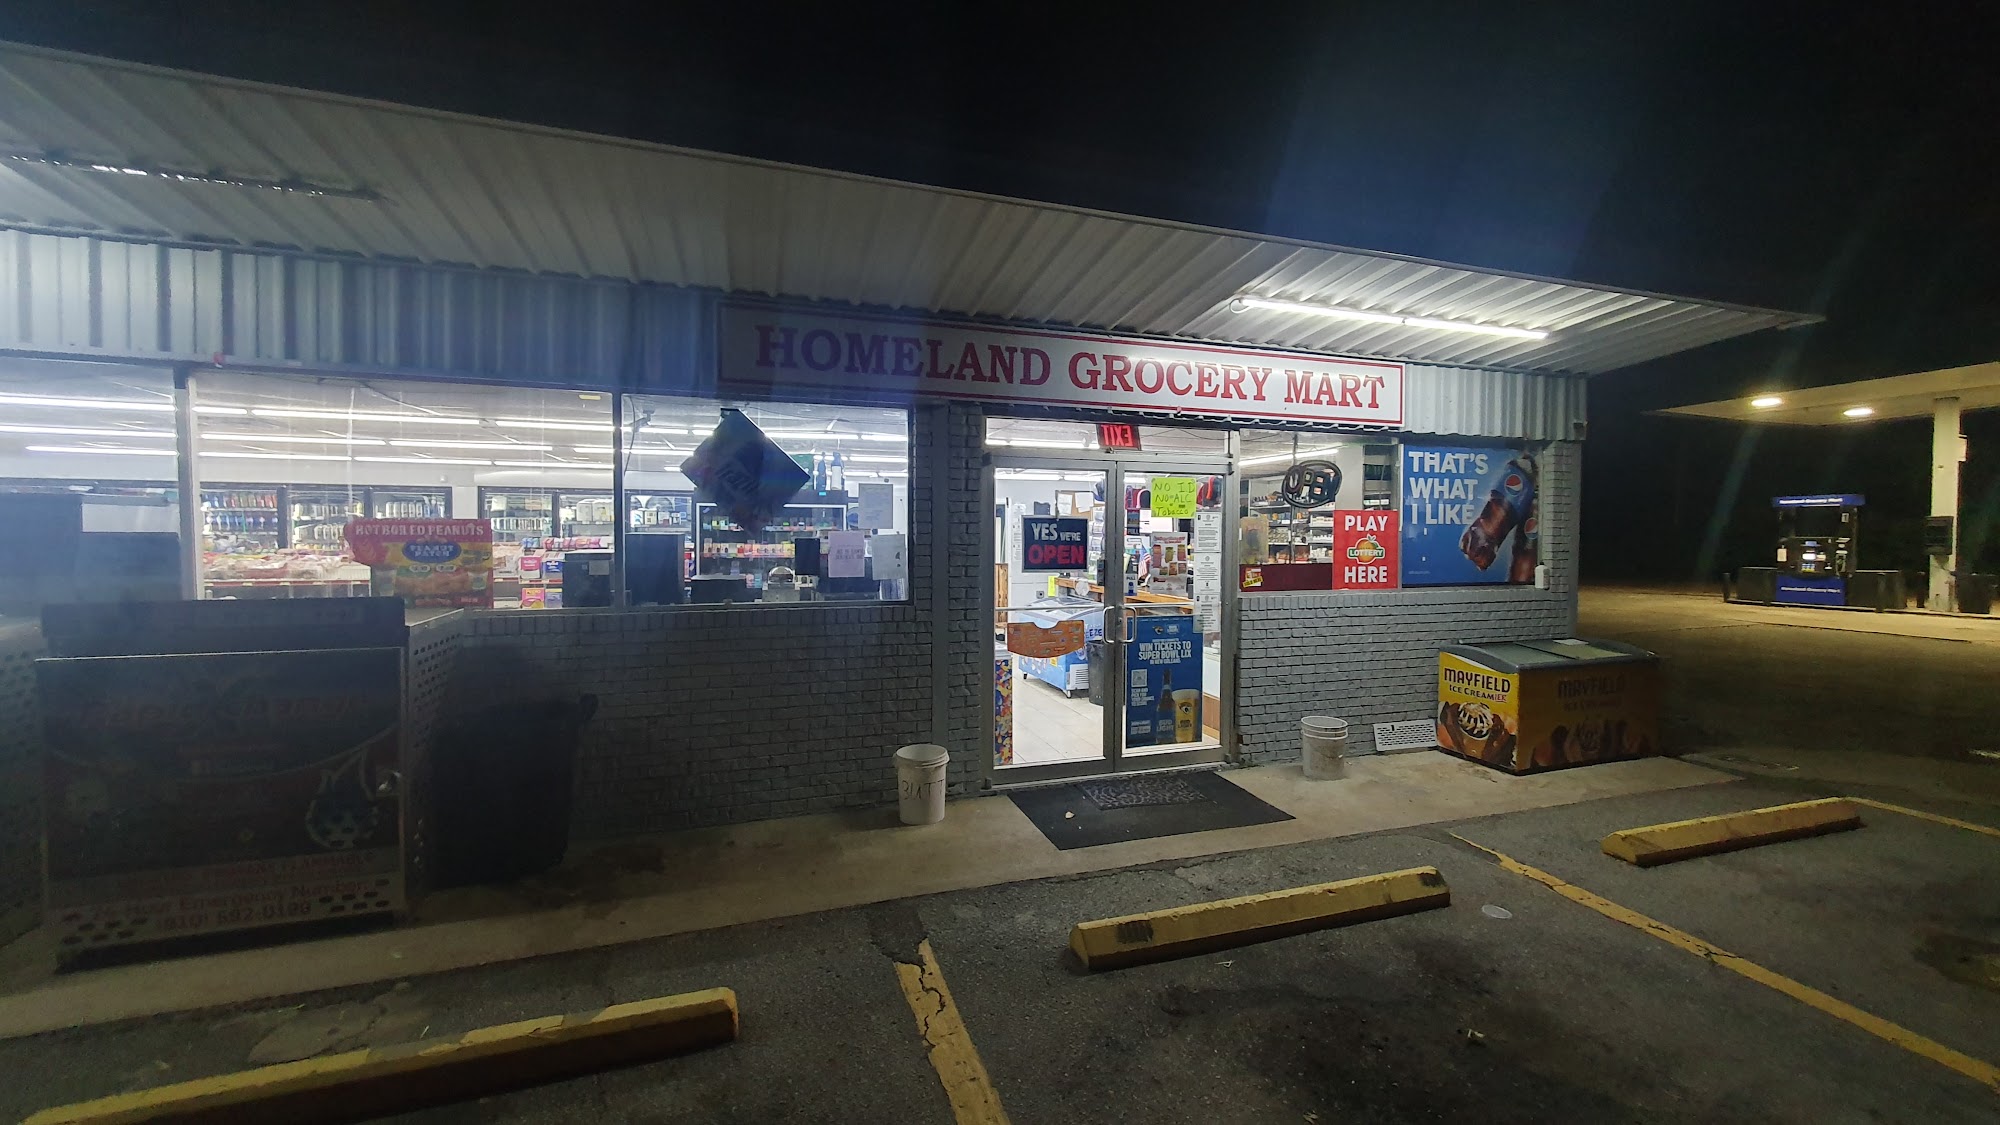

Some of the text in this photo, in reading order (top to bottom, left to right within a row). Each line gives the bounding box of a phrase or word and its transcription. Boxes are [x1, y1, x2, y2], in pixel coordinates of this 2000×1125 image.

[755, 325, 1385, 409] HOMELAND GROCERY MART
[1408, 451, 1489, 475] THAT'S
[1154, 482, 1196, 494] NO ID
[1409, 477, 1478, 501] WHAT
[1156, 507, 1189, 517] Tobacco
[1411, 503, 1475, 525] I LIKE
[356, 525, 484, 536] HOT BOILED PEANUTS
[1345, 515, 1388, 531] PLAY
[1031, 523, 1058, 540] YES
[1028, 544, 1085, 565] OPEN
[1350, 549, 1384, 557] LOTTERY
[1344, 566, 1388, 583] HERE
[1139, 643, 1153, 652] WIN
[1154, 642, 1181, 651] TICKETS
[1182, 640, 1192, 650] TO
[1139, 648, 1192, 660] SUPER BOWL LIX
[1444, 667, 1511, 693] MAYFIELD
[1449, 684, 1463, 694] ICE
